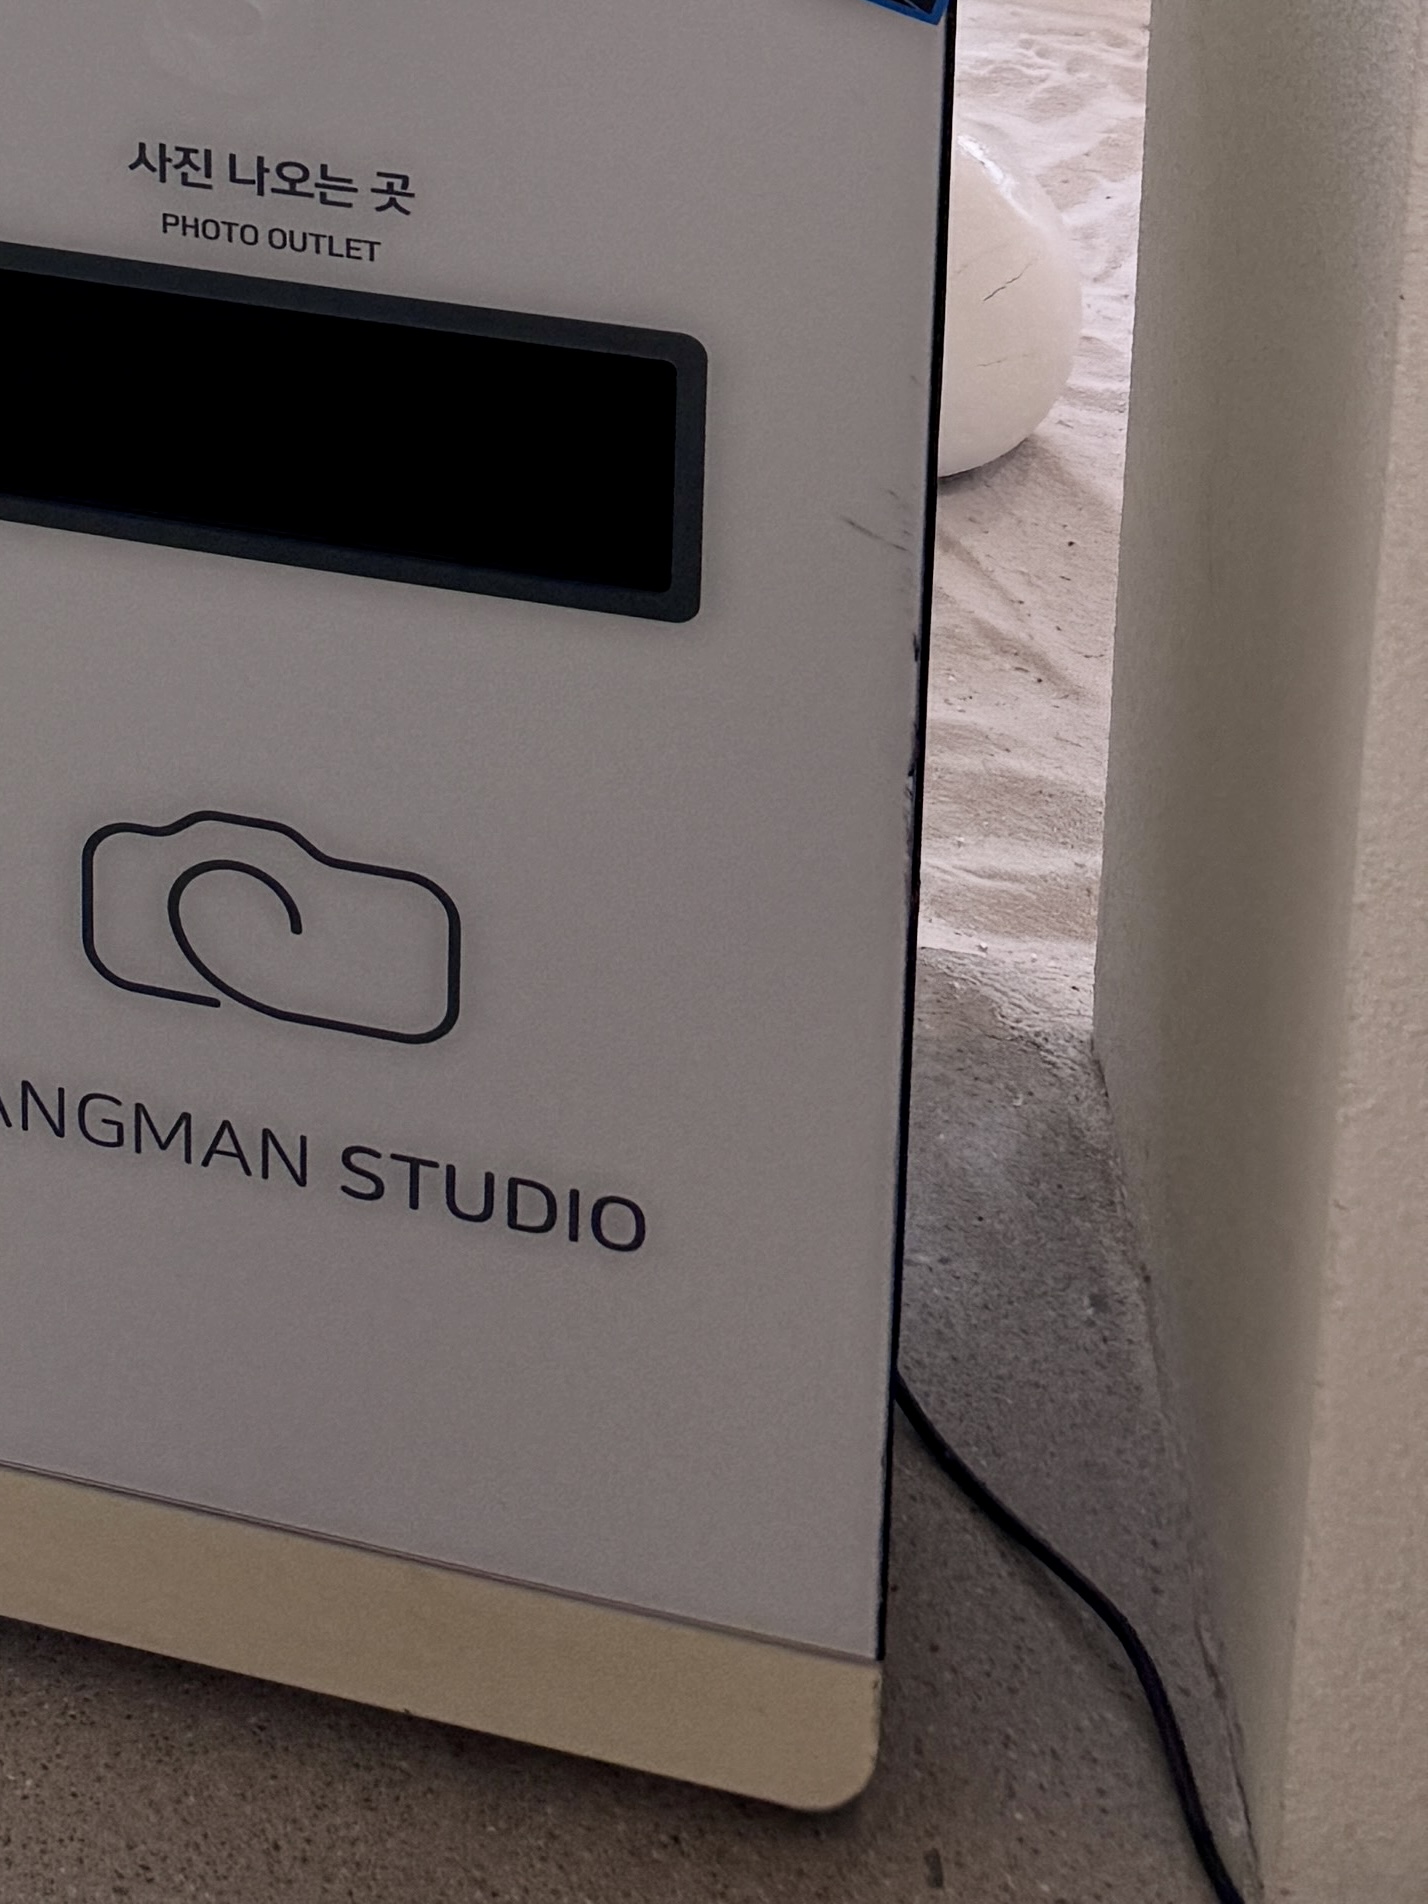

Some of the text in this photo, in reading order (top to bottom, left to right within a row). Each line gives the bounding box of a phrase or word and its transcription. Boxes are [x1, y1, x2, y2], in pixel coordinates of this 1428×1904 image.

[128, 141, 416, 216] 사진 나오는 곳
[162, 212, 382, 263] PHOTO OUTLET
[339, 1144, 648, 1253] STUDIO
